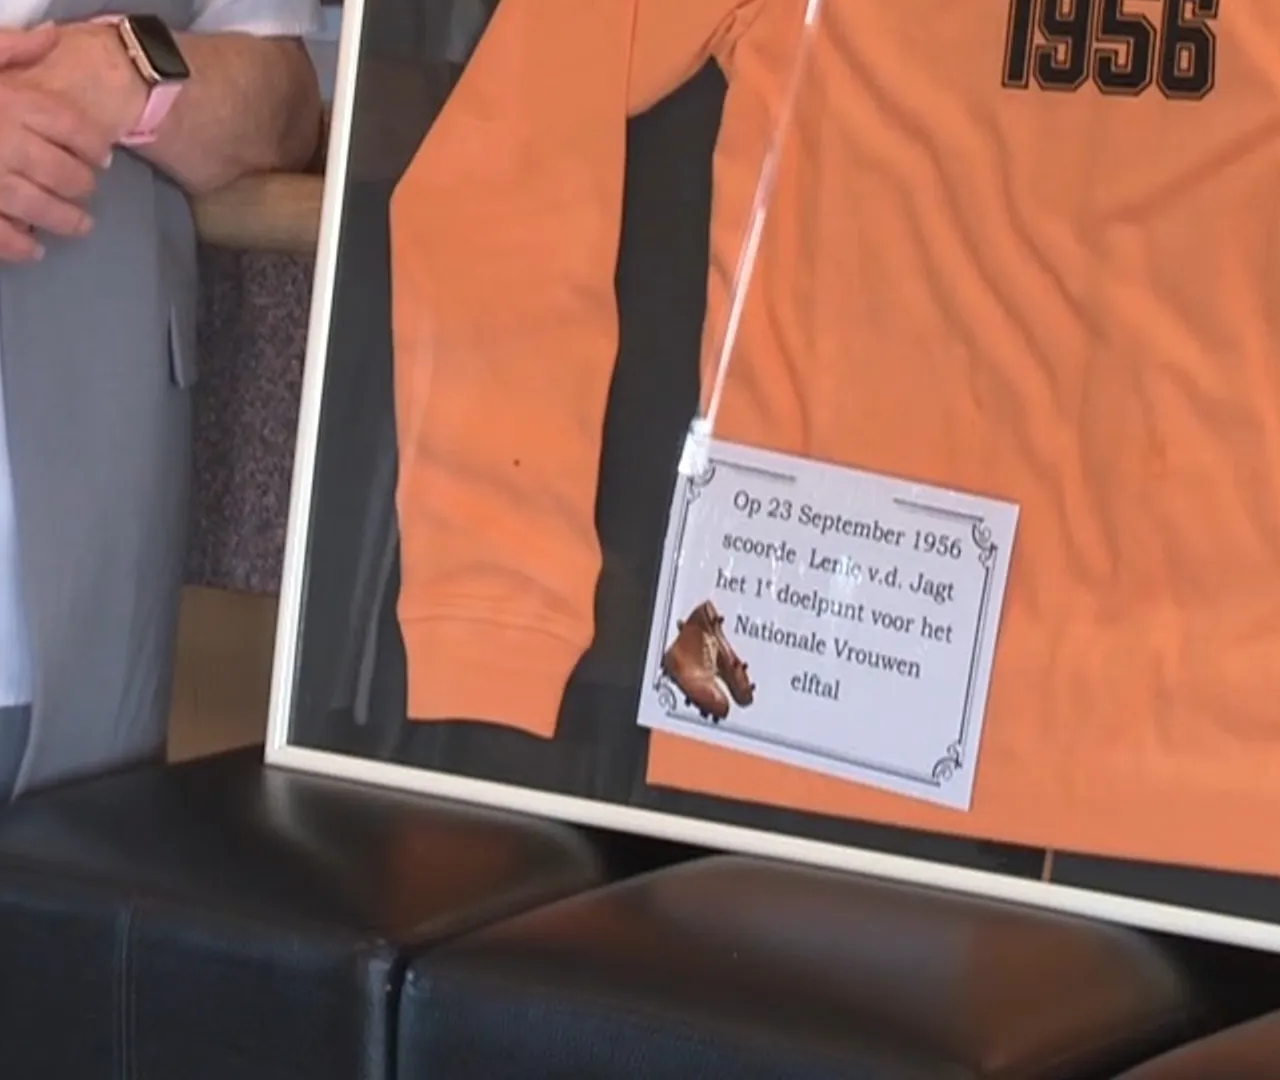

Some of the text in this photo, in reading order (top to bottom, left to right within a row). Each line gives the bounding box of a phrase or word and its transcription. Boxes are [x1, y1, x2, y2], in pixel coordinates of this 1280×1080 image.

[733, 490, 962, 559] Op 23 September 1956
[722, 533, 797, 564] scoorde
[868, 565, 902, 589] v.d.
[909, 572, 954, 604] Jagt
[716, 568, 746, 594] het
[777, 584, 864, 622] doelpunt
[871, 609, 915, 633] voor
[921, 616, 953, 643] het
[734, 614, 921, 678] Nationale Vrouwen
[790, 672, 840, 701] elftal
